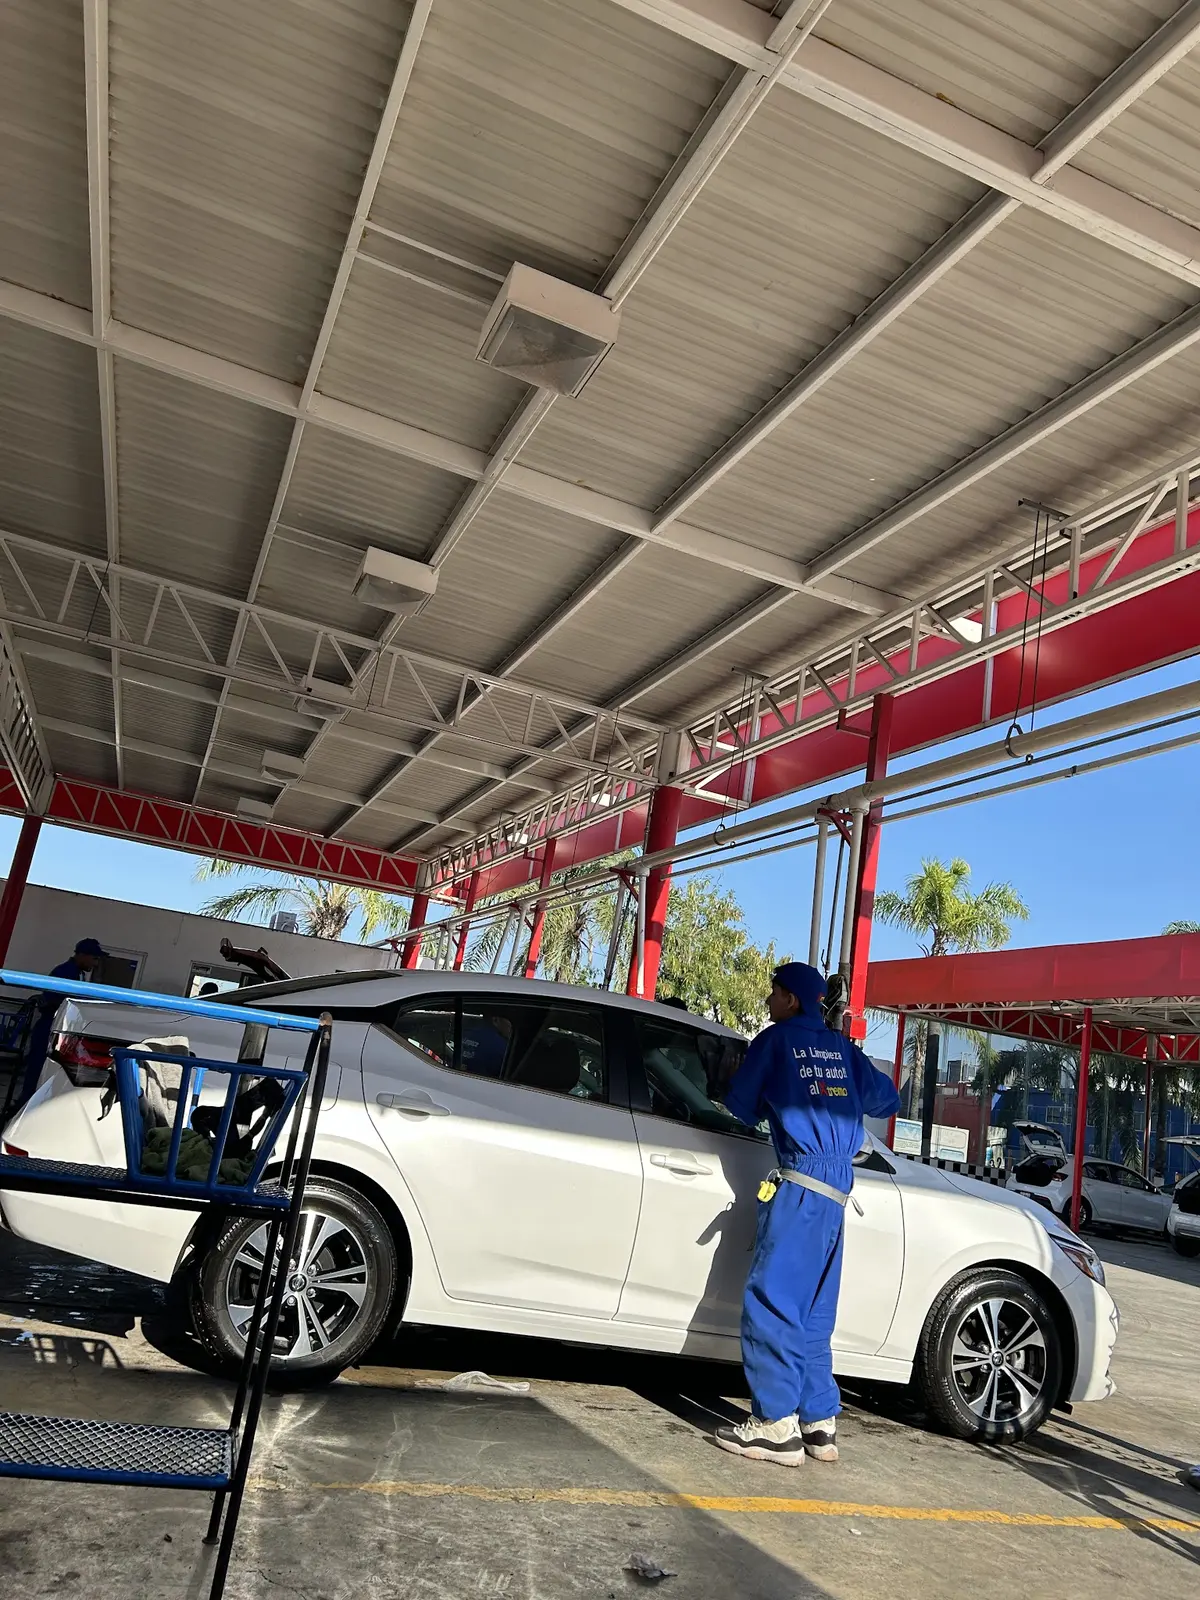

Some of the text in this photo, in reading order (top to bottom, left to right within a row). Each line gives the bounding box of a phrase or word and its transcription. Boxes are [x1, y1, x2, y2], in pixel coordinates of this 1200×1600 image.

[793, 1046, 842, 1061] La Limpieza
[800, 1064, 813, 1078] de
[814, 1064, 824, 1078] tu
[809, 1080, 820, 1095] al
